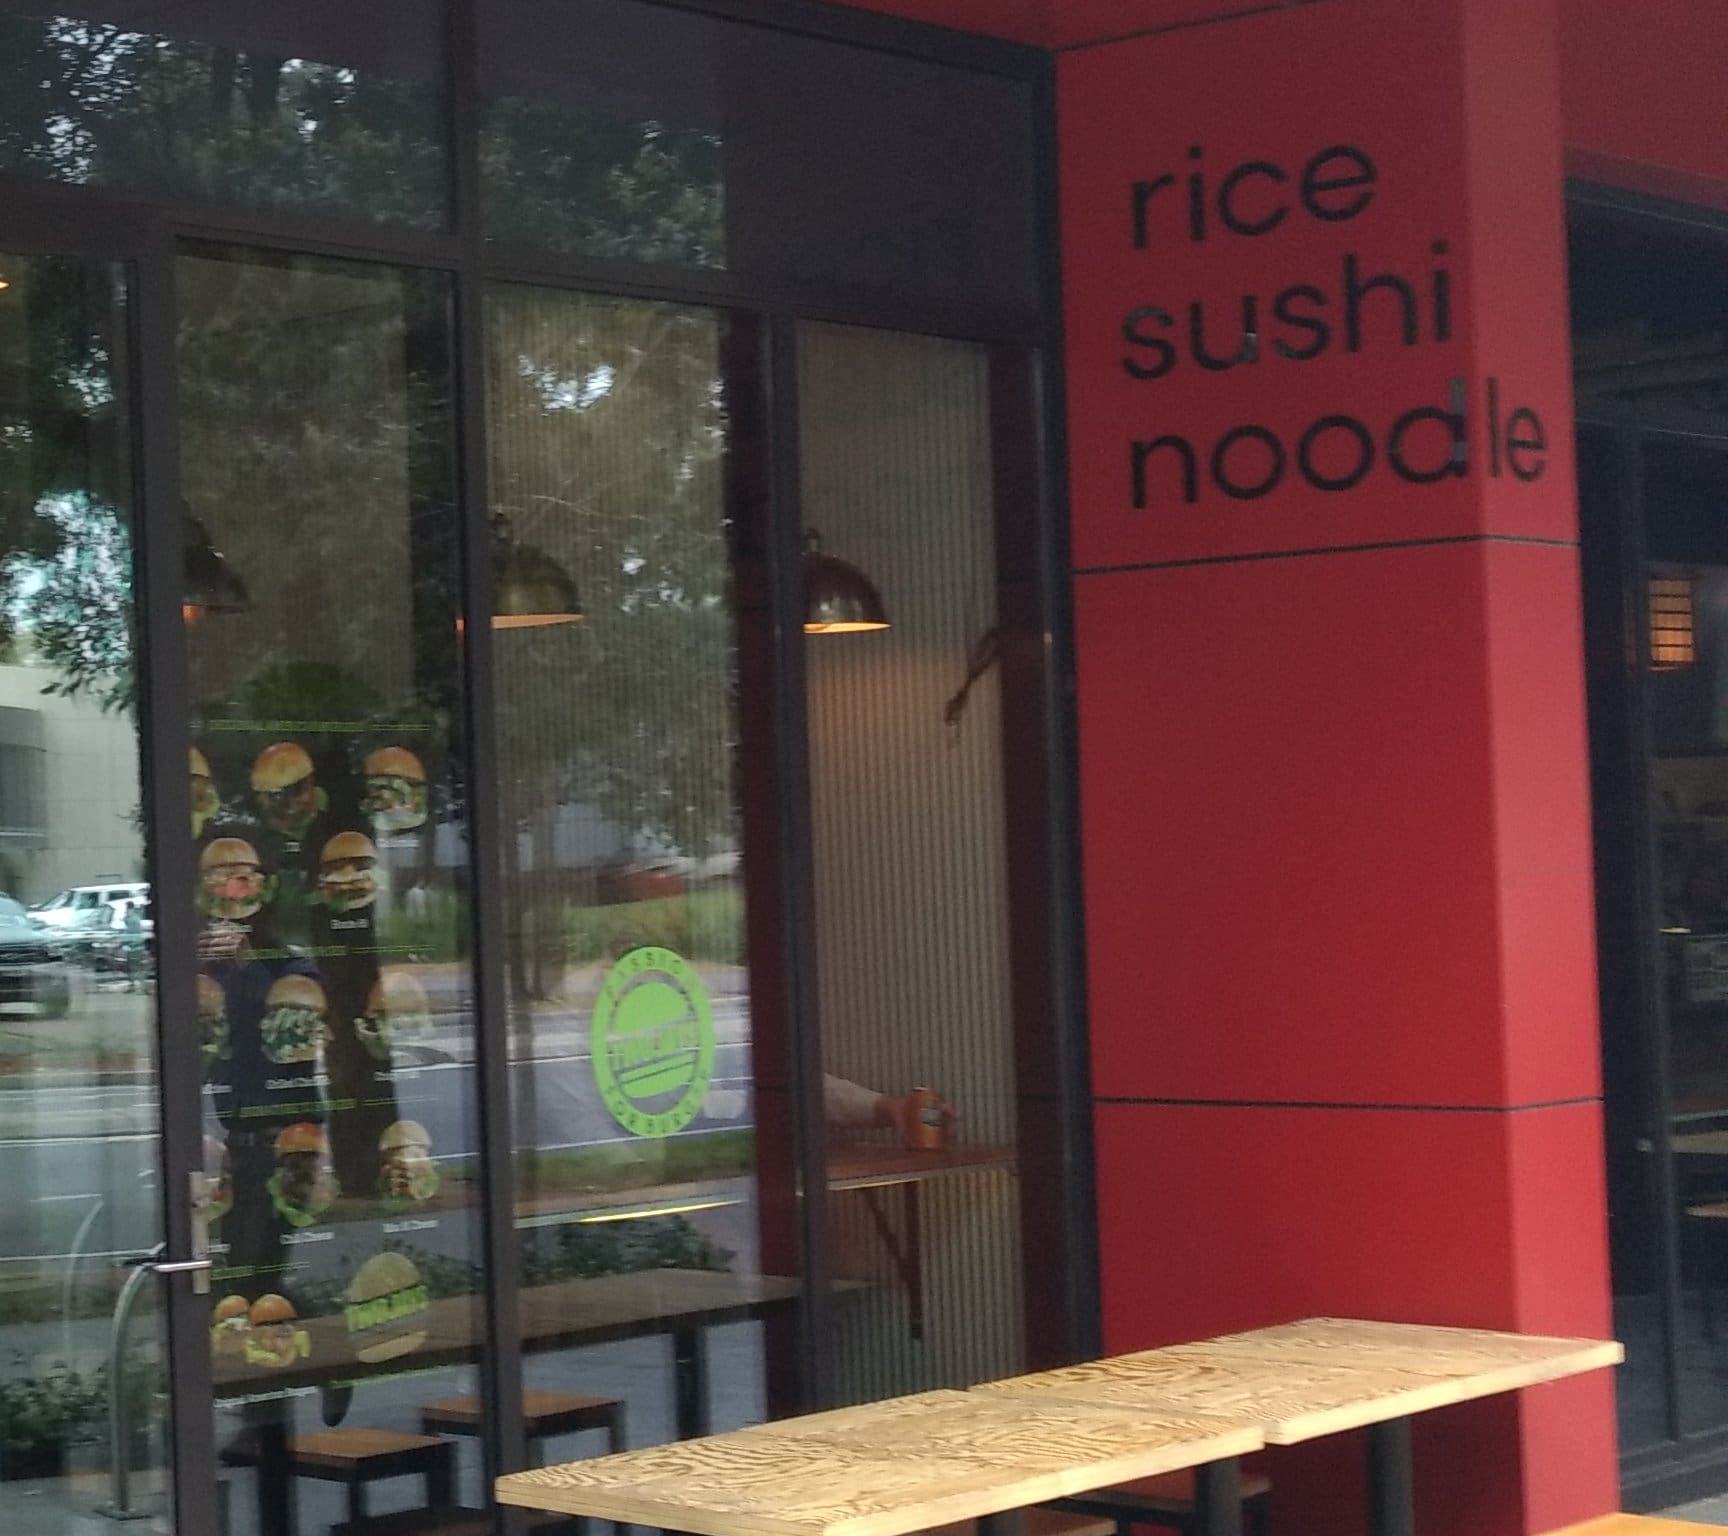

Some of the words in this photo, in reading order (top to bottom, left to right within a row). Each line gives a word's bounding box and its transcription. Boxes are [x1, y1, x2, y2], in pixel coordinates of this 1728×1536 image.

[1130, 145, 1378, 250] rice
[1121, 240, 1452, 380] sushi
[1129, 376, 1546, 510] noodle
